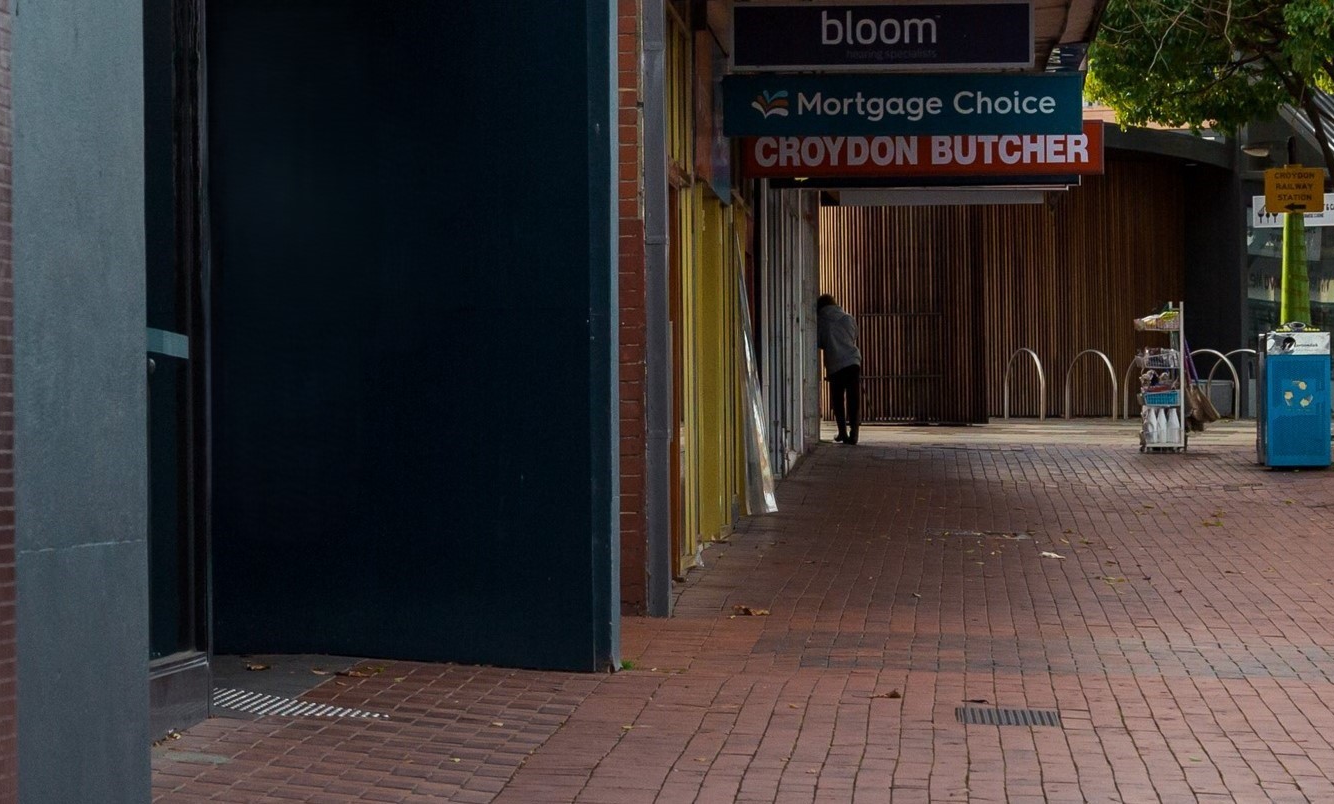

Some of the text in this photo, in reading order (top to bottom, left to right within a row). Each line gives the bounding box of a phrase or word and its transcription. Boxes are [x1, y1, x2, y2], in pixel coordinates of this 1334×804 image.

[821, 10, 938, 45] bloom
[797, 90, 1056, 122] Mortgage Choice
[754, 134, 1089, 167] CROYDON BUTCHER
[1274, 172, 1315, 180] CROYDON
